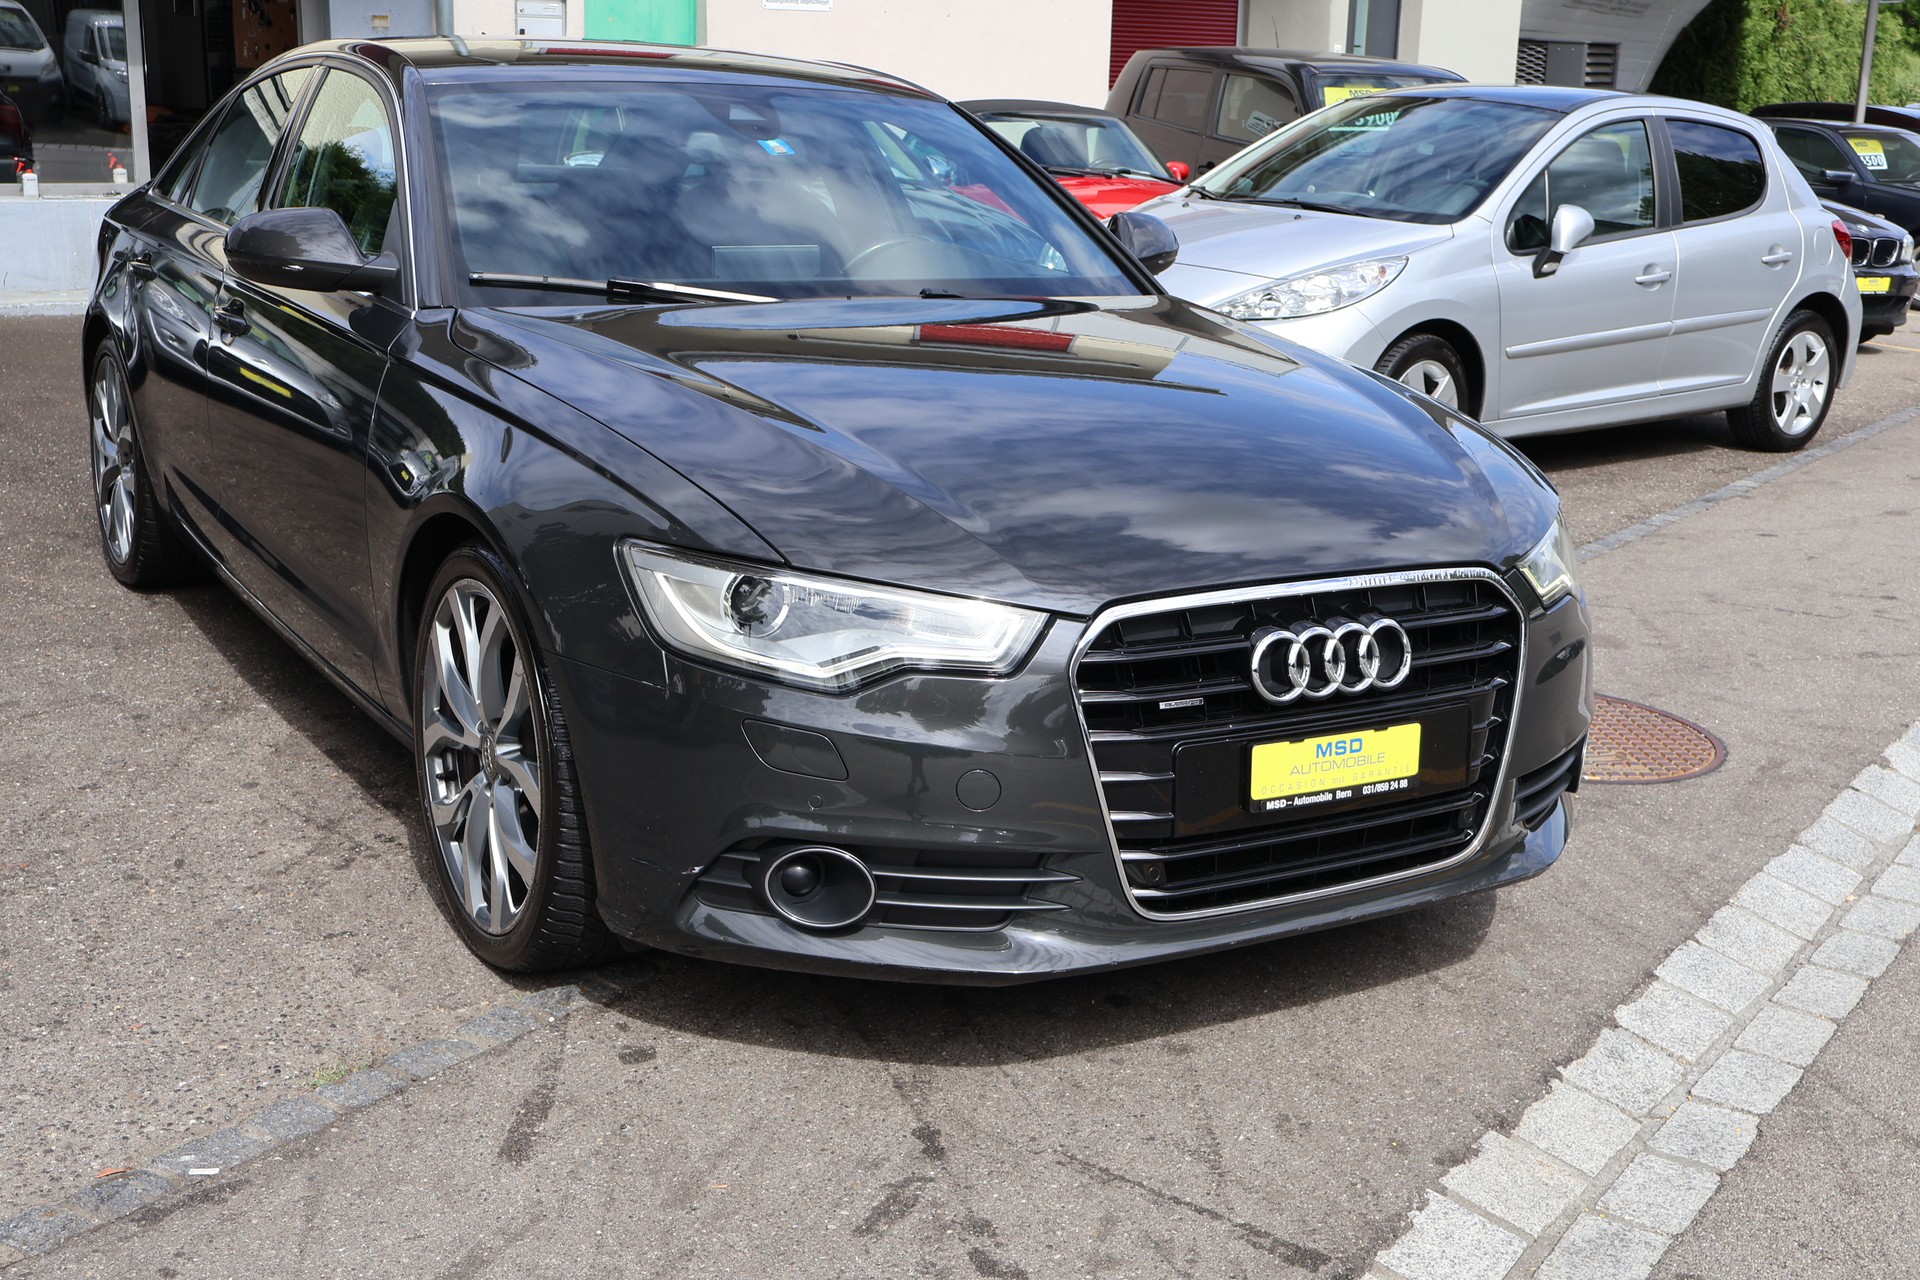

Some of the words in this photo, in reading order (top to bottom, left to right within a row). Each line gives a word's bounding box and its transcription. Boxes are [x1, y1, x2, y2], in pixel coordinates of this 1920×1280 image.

[1315, 737, 1364, 759] MSD
[1289, 752, 1386, 777] AUTOMOBILE
[1261, 778, 1326, 795] OCCASION
[1331, 776, 1345, 785] mit
[1352, 764, 1411, 781] GARANTIE
[1335, 789, 1352, 799] Bern
[1362, 782, 1389, 795] 031/859
[1389, 780, 1399, 790] 24
[1399, 778, 1408, 789] 88
